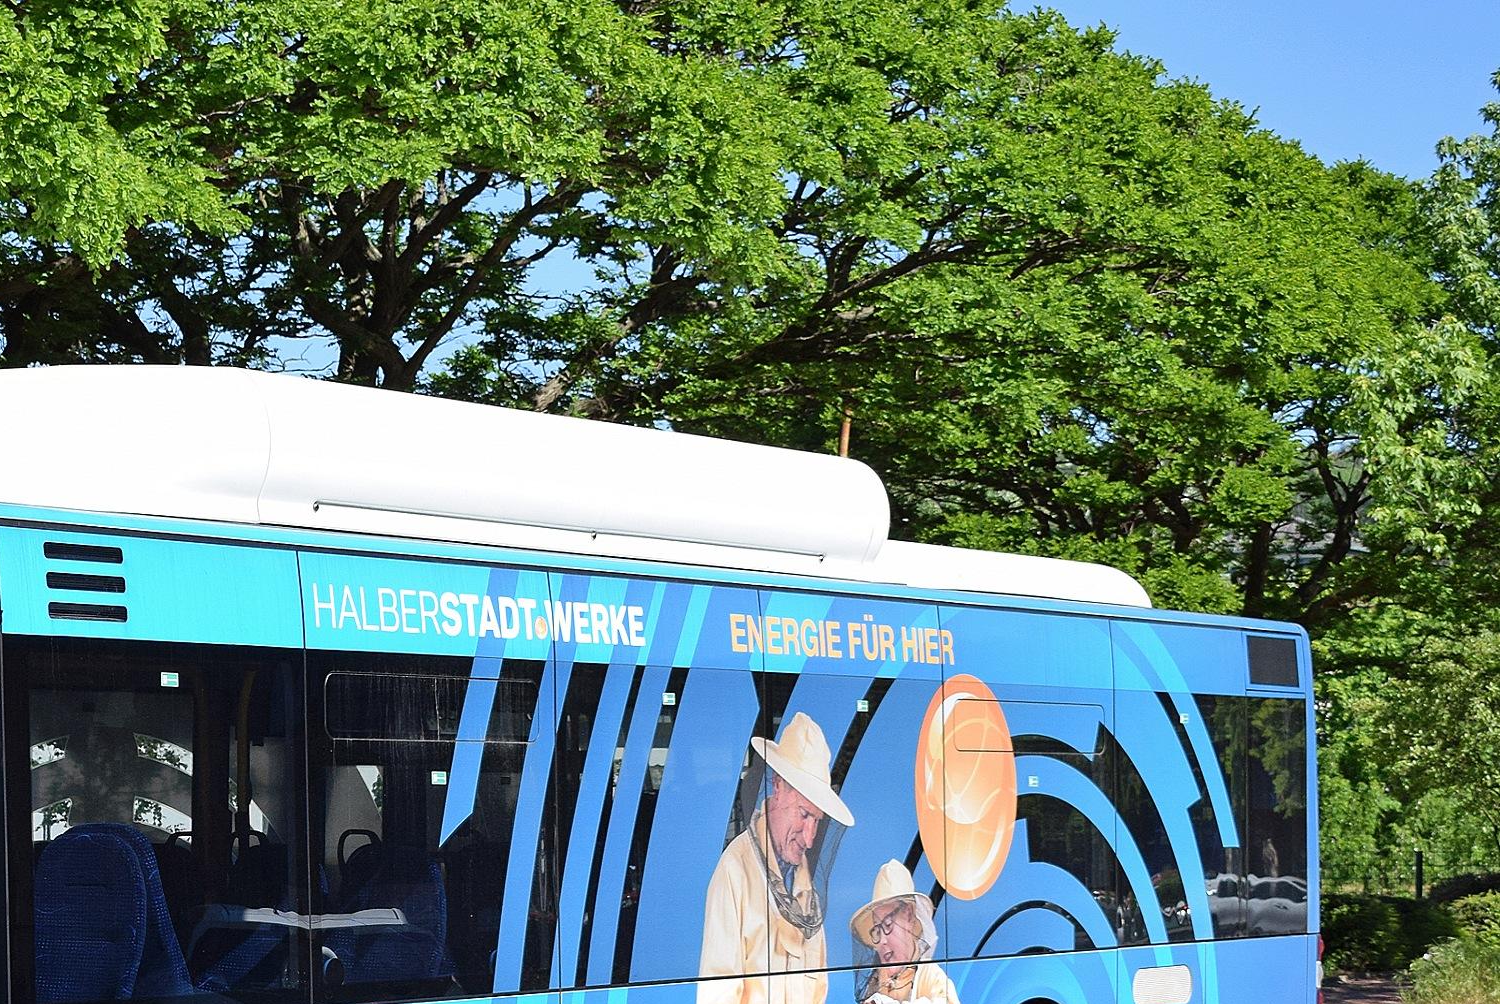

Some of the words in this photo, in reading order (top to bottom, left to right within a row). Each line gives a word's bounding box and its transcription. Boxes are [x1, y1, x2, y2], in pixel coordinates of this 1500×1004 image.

[729, 613, 843, 659] ENERGIE
[847, 614, 896, 662] FÜR
[900, 626, 955, 666] HIER
